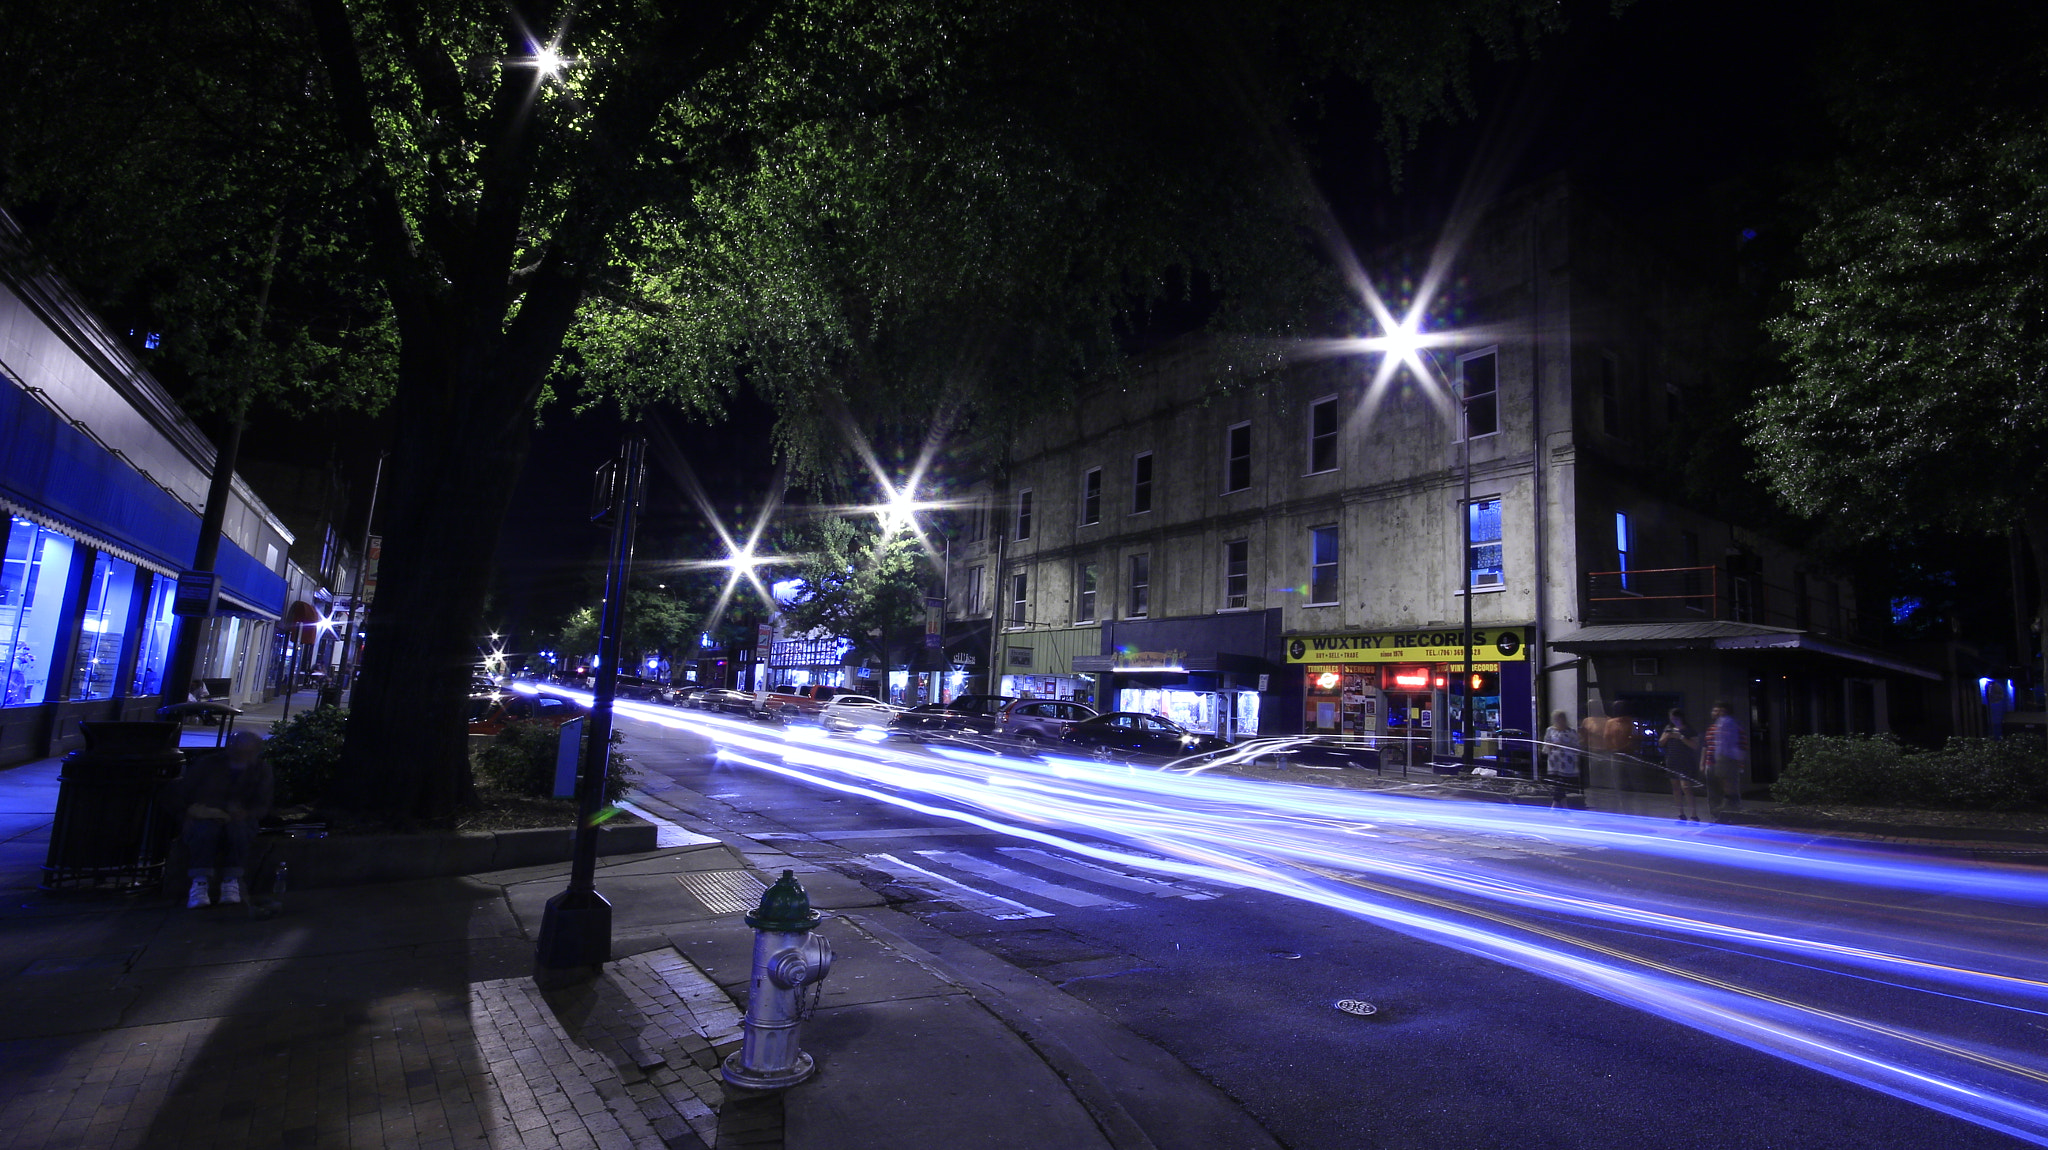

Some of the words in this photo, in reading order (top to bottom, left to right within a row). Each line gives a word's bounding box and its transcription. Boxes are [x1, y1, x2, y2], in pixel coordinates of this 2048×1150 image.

[1312, 636, 1384, 650] WUXTRY
[1394, 631, 1487, 648] RECORS
[1344, 651, 1359, 659] TRADE
[1345, 665, 1375, 673] STEREOS
[1450, 664, 1465, 672] VINY
